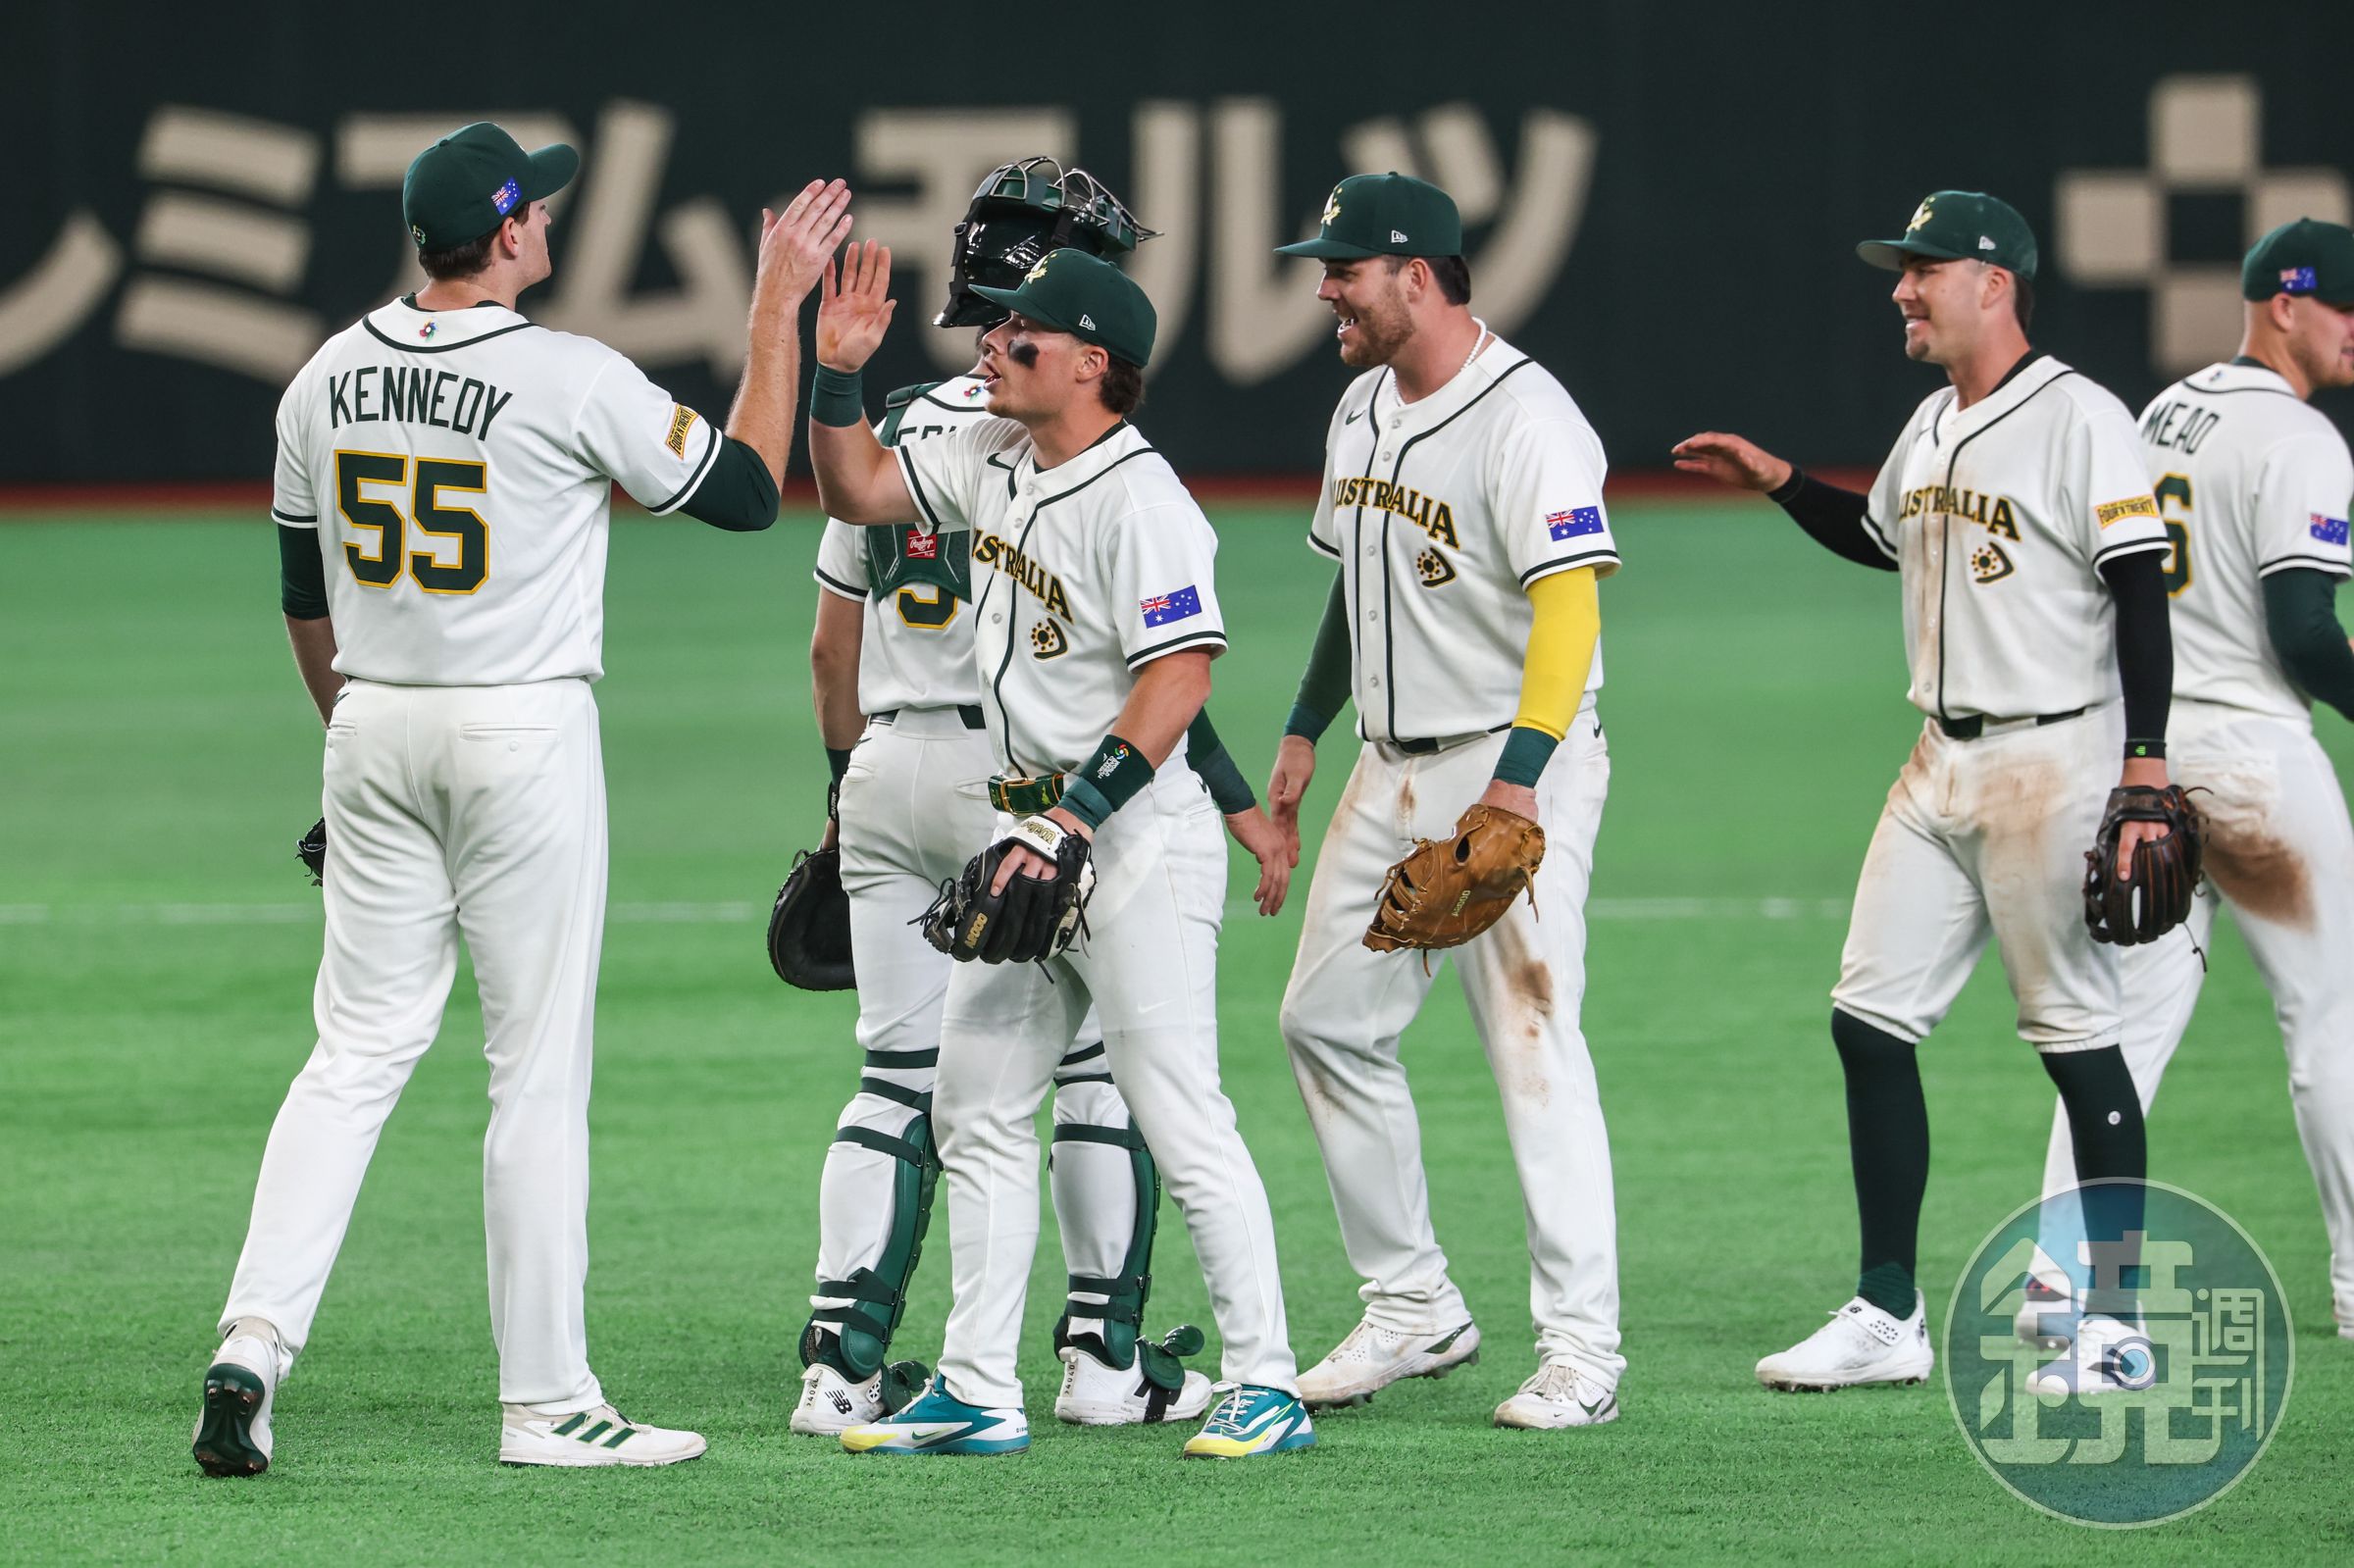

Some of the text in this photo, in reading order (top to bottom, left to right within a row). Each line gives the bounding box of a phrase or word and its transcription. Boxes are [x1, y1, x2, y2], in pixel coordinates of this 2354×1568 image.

[330, 366, 513, 441] KENNEDY
[2141, 401, 2221, 455] MEAD
[333, 449, 489, 595] 55
[2154, 472, 2193, 597] 6
